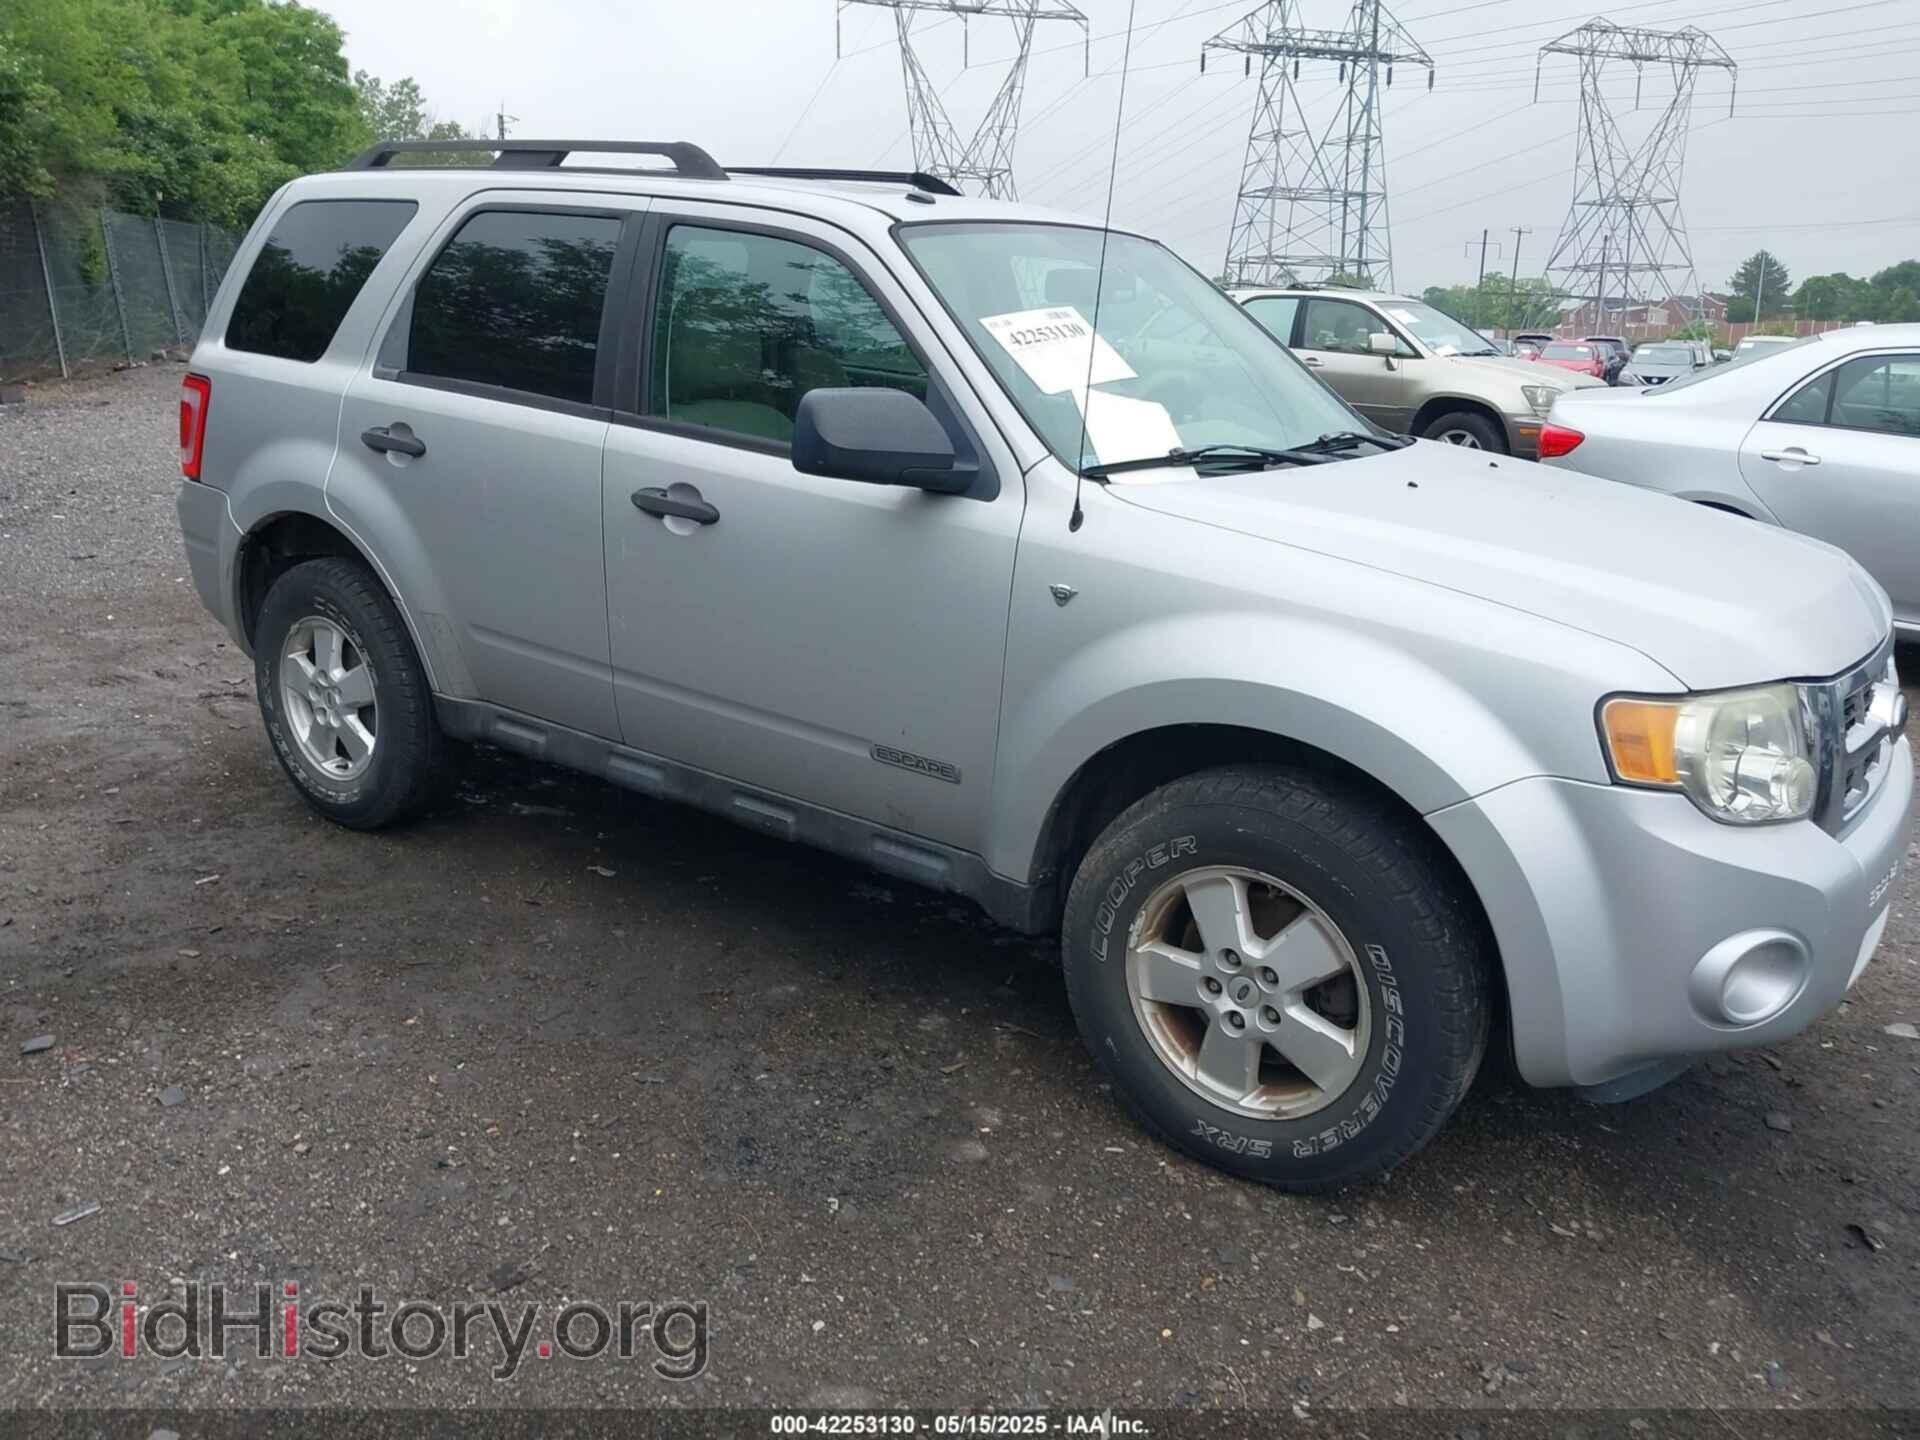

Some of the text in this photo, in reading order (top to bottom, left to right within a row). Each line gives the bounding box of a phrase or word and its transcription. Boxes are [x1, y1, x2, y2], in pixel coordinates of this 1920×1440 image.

[1009, 322, 1086, 346] 42253130
[876, 747, 955, 778] ESCAPE
[1090, 835, 1197, 961] COOPER
[1189, 943, 1404, 1159] DISCOVERER SRX
